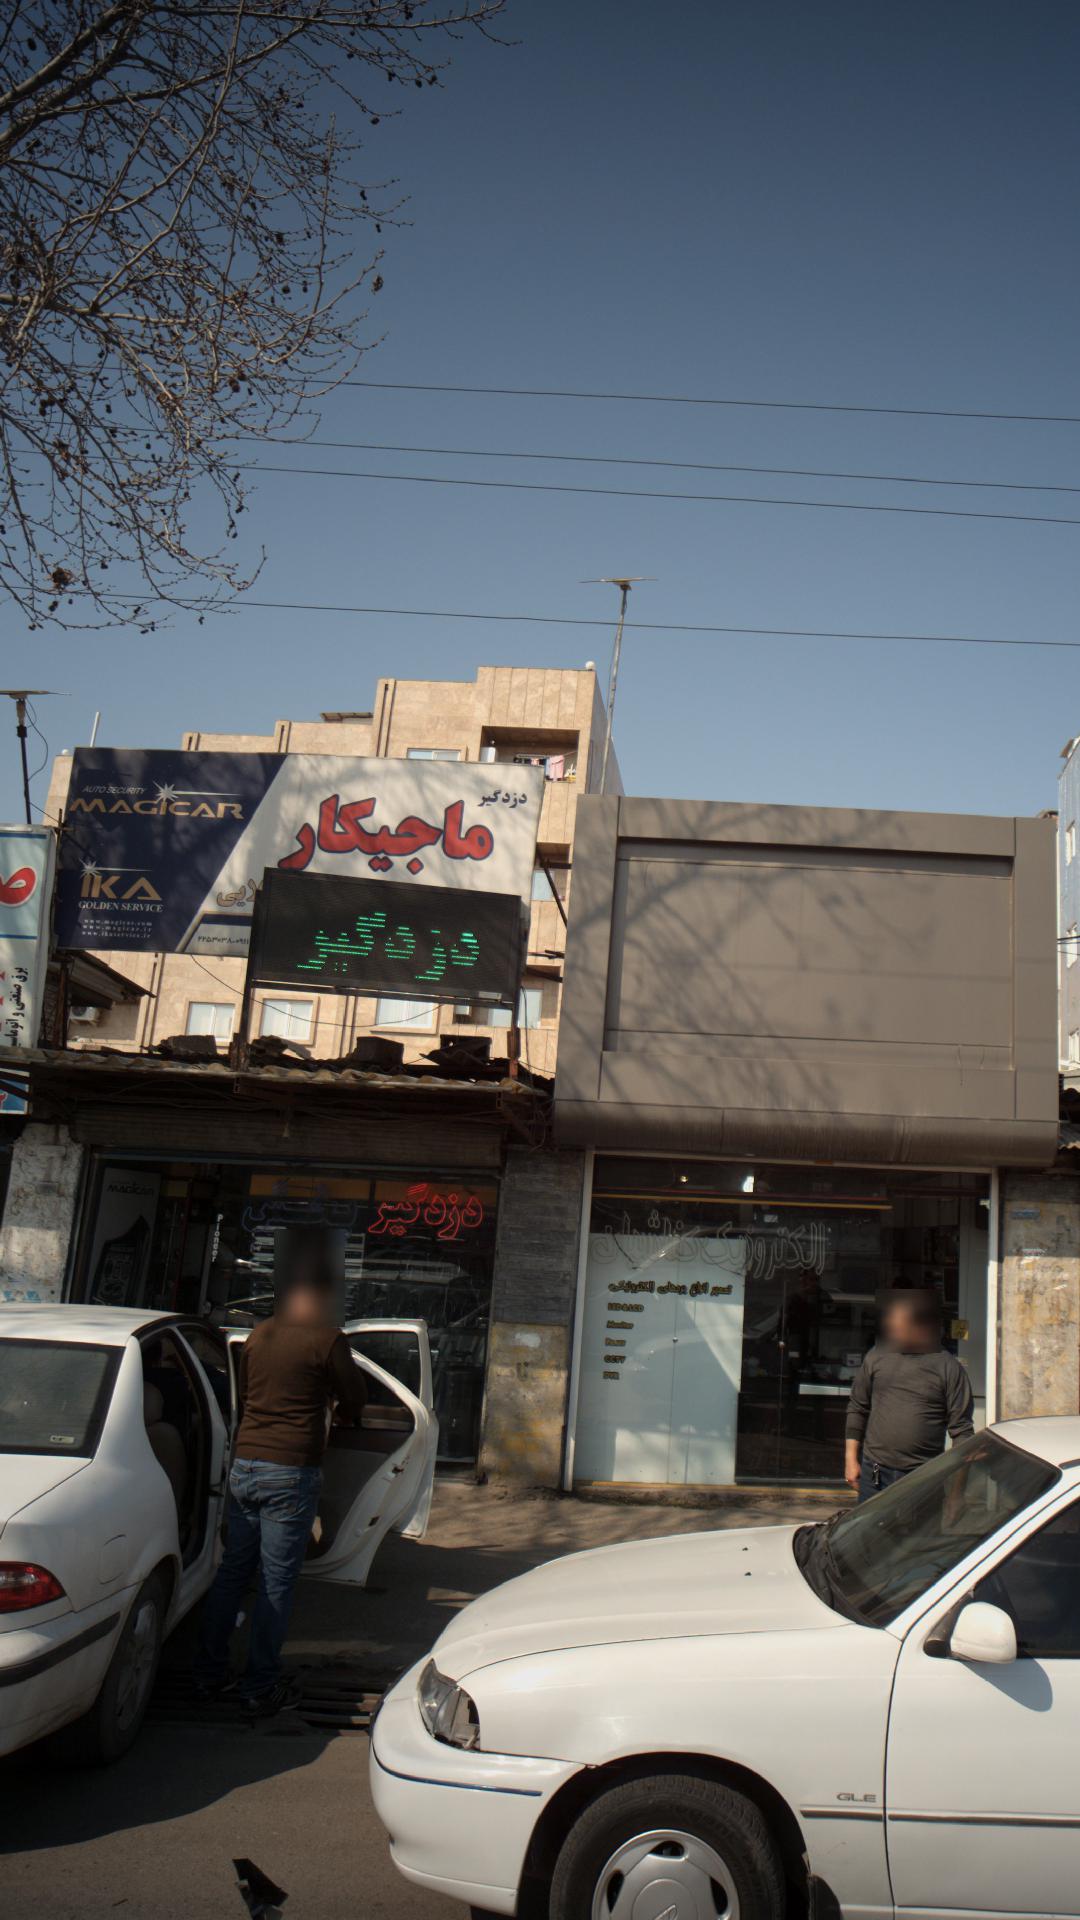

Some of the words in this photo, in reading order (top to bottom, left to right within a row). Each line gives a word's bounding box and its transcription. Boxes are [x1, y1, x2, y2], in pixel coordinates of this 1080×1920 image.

[82, 784, 107, 795] AUTO
[107, 785, 146, 796] SECURITY
[478, 790, 528, 808] دزدگیر
[69, 798, 244, 820] MAGICAR
[277, 793, 495, 876] ماجیکار
[80, 873, 163, 901] IKA
[79, 901, 120, 911] GOLDEN
[120, 902, 164, 913] SERVICE
[297, 912, 480, 982] دزدگیر
[14, 967, 29, 983] برق
[9, 984, 26, 1011] صنعتی
[368, 1183, 483, 1240] دزدگیر
[836, 1793, 877, 1803] GLE
